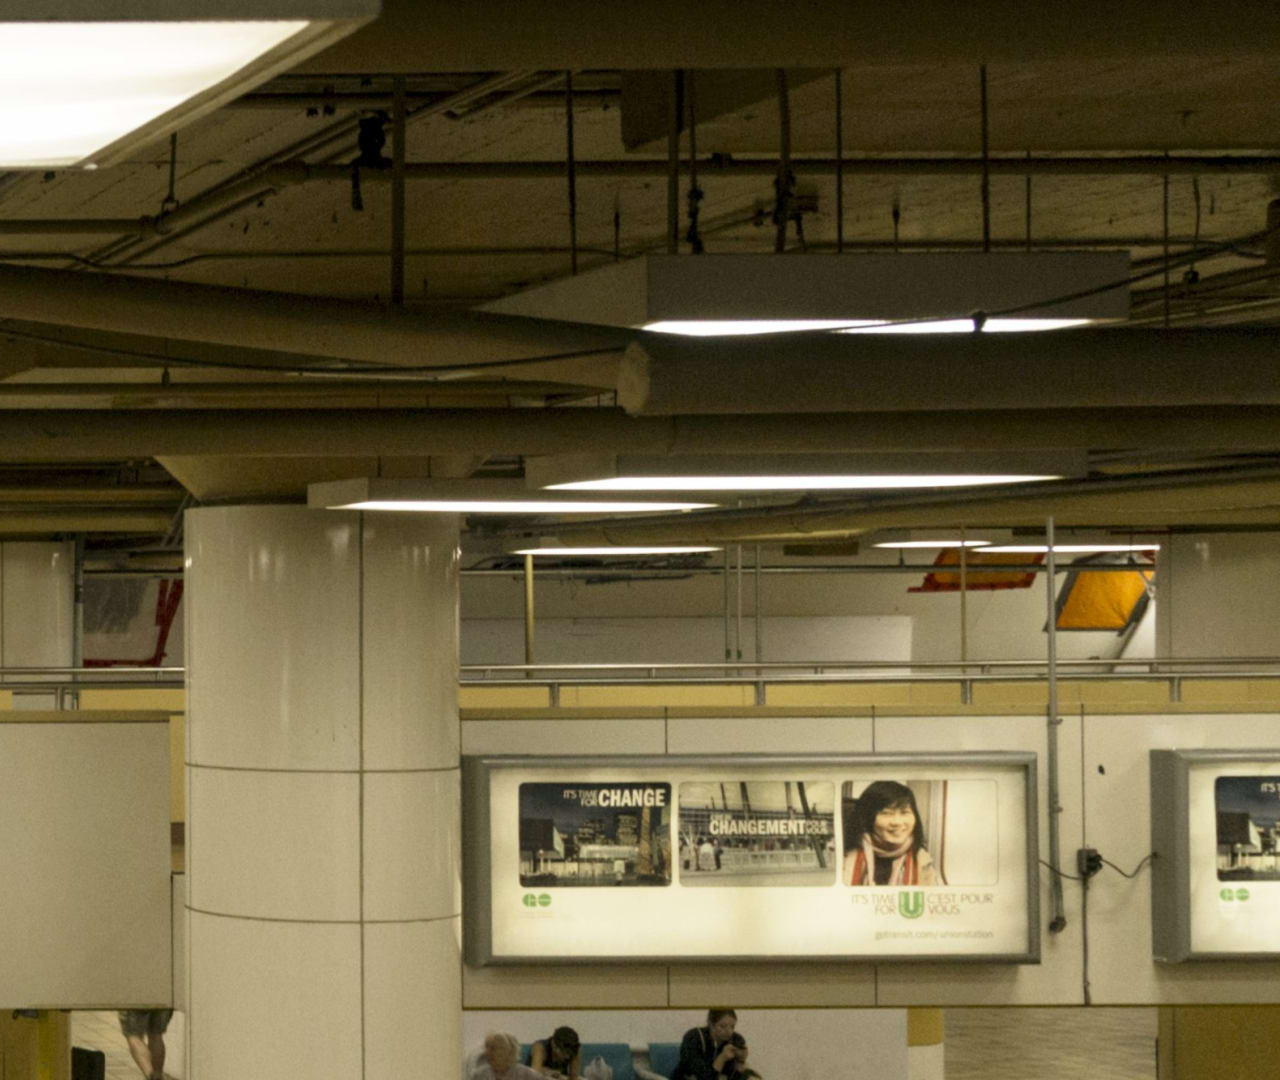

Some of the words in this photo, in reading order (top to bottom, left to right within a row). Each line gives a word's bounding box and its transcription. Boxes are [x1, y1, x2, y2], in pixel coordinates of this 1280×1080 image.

[598, 788, 667, 808] CHANGE
[709, 819, 807, 835] CHANGEMENT
[960, 892, 994, 904] POUR
[928, 904, 960, 915] VOUS
